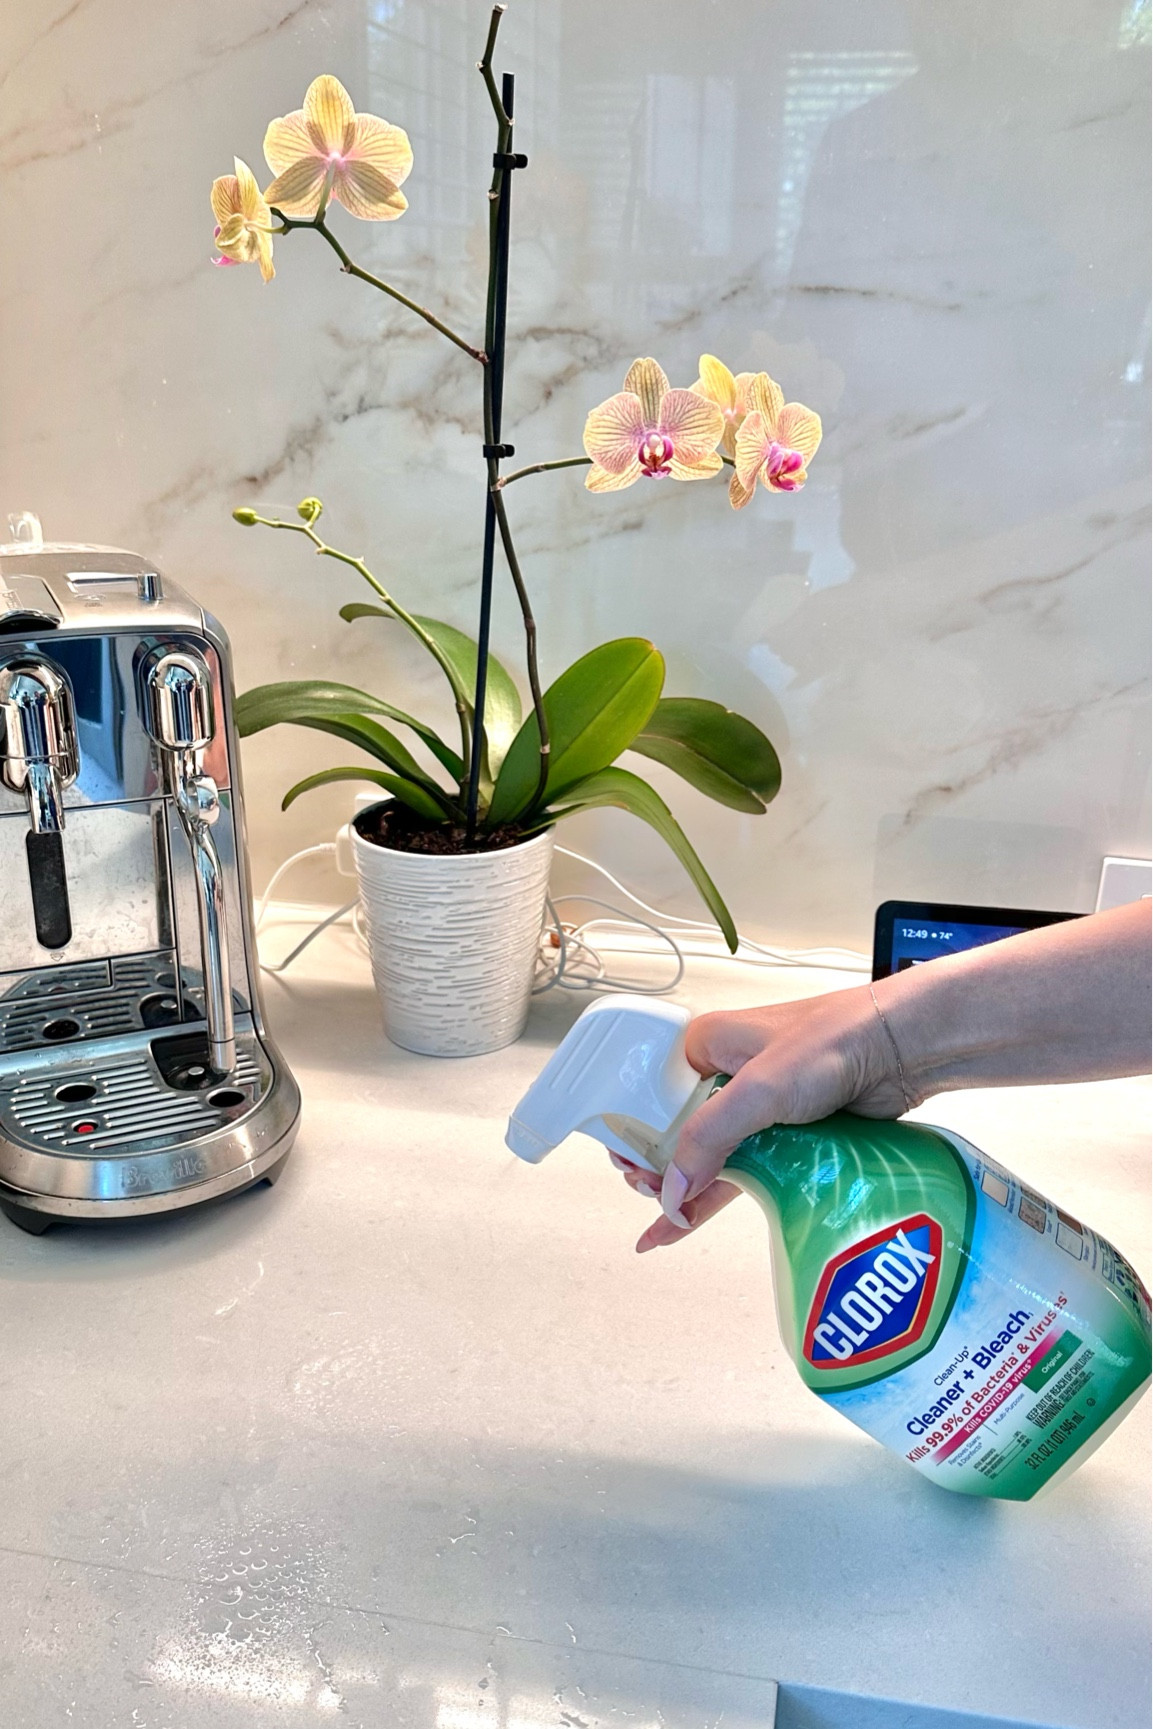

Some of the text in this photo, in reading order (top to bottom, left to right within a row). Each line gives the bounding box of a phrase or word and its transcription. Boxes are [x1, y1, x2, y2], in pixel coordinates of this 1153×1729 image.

[902, 928, 928, 939] 12:49
[813, 1228, 936, 1360] CLOROX
[1041, 1350, 1064, 1374] Original
[906, 1380, 965, 1436] Cleaner
[963, 1369, 975, 1380] +
[906, 1443, 931, 1463] Kills
[925, 1413, 963, 1448] 99.9%
[962, 1400, 976, 1416] of
[1016, 1343, 1030, 1355] &
[963, 1417, 982, 1434] Kills
[979, 1382, 1013, 1418] COVID-19
[1026, 1408, 1039, 1420] KEEP
[1035, 1398, 1048, 1411] OUT
[1044, 1393, 1053, 1402] OF
[1050, 1378, 1067, 1395] REACH
[1063, 1371, 1073, 1381] OF
[1025, 1457, 1038, 1470] 32
[1032, 1450, 1044, 1463] FL
[1038, 1443, 1052, 1457] OZ
[1060, 1418, 1076, 1434] 946
[1069, 1408, 1084, 1424] mL
